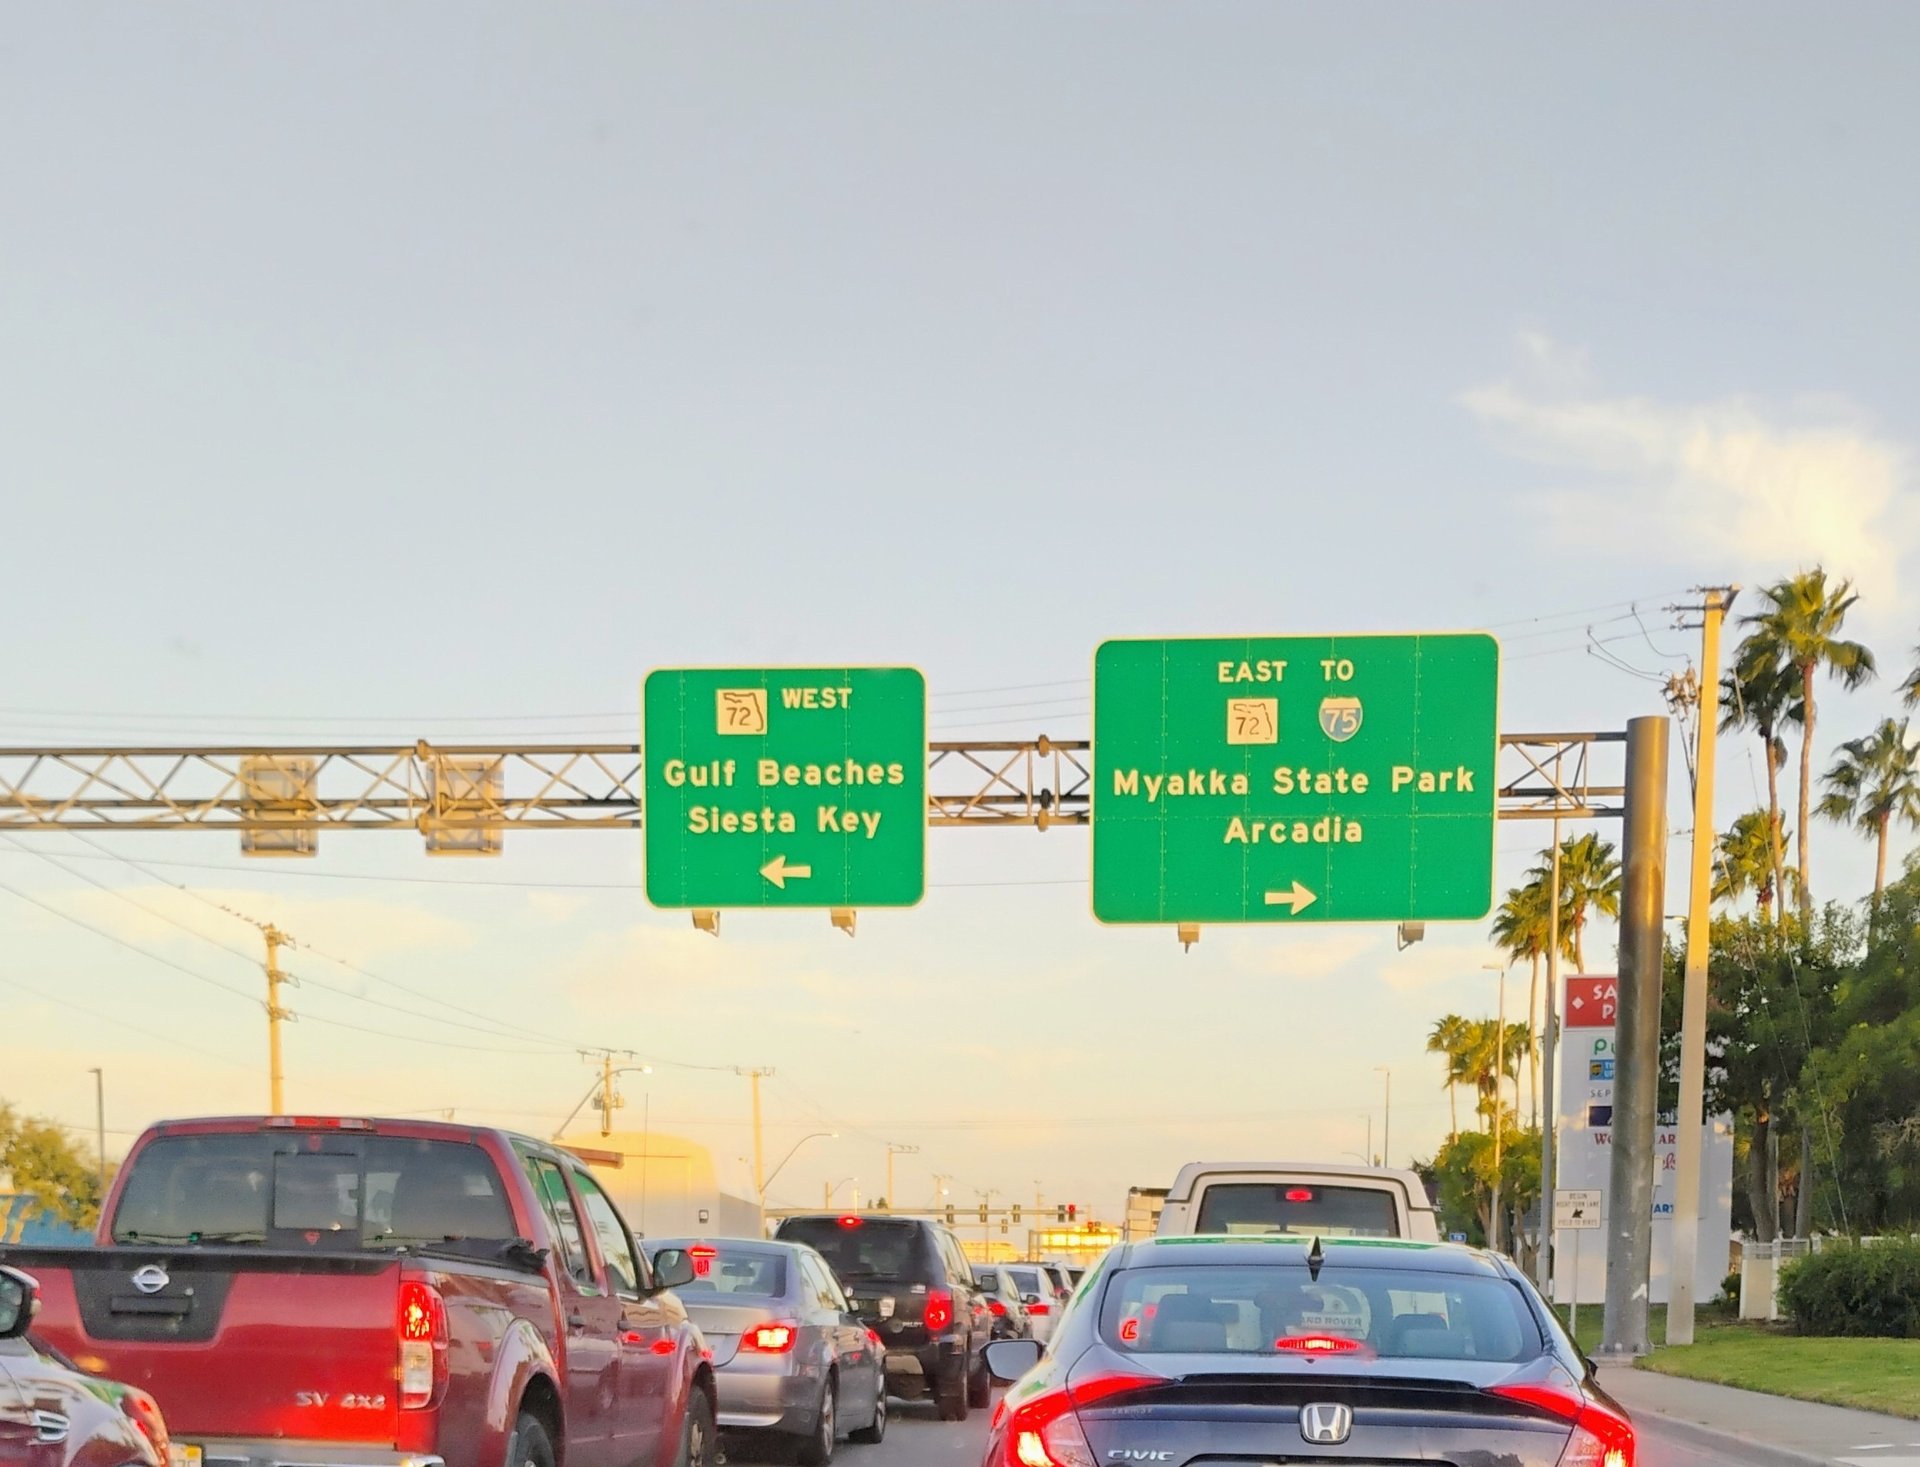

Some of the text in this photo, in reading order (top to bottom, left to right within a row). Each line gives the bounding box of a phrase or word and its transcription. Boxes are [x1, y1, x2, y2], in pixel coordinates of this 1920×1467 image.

[1218, 659, 1354, 683] EAST TO
[726, 688, 852, 726] 72 WEST
[1235, 708, 1358, 736] 72 75
[664, 758, 905, 787] Gulf Beaches
[1113, 765, 1474, 802] Myakka State Park
[688, 805, 881, 839] Siesta Key
[1223, 816, 1363, 844] Arcadia
[1325, 1316, 1362, 1327] ROVER
[296, 1391, 330, 1408] SV
[1107, 1449, 1176, 1461] CIVIC
